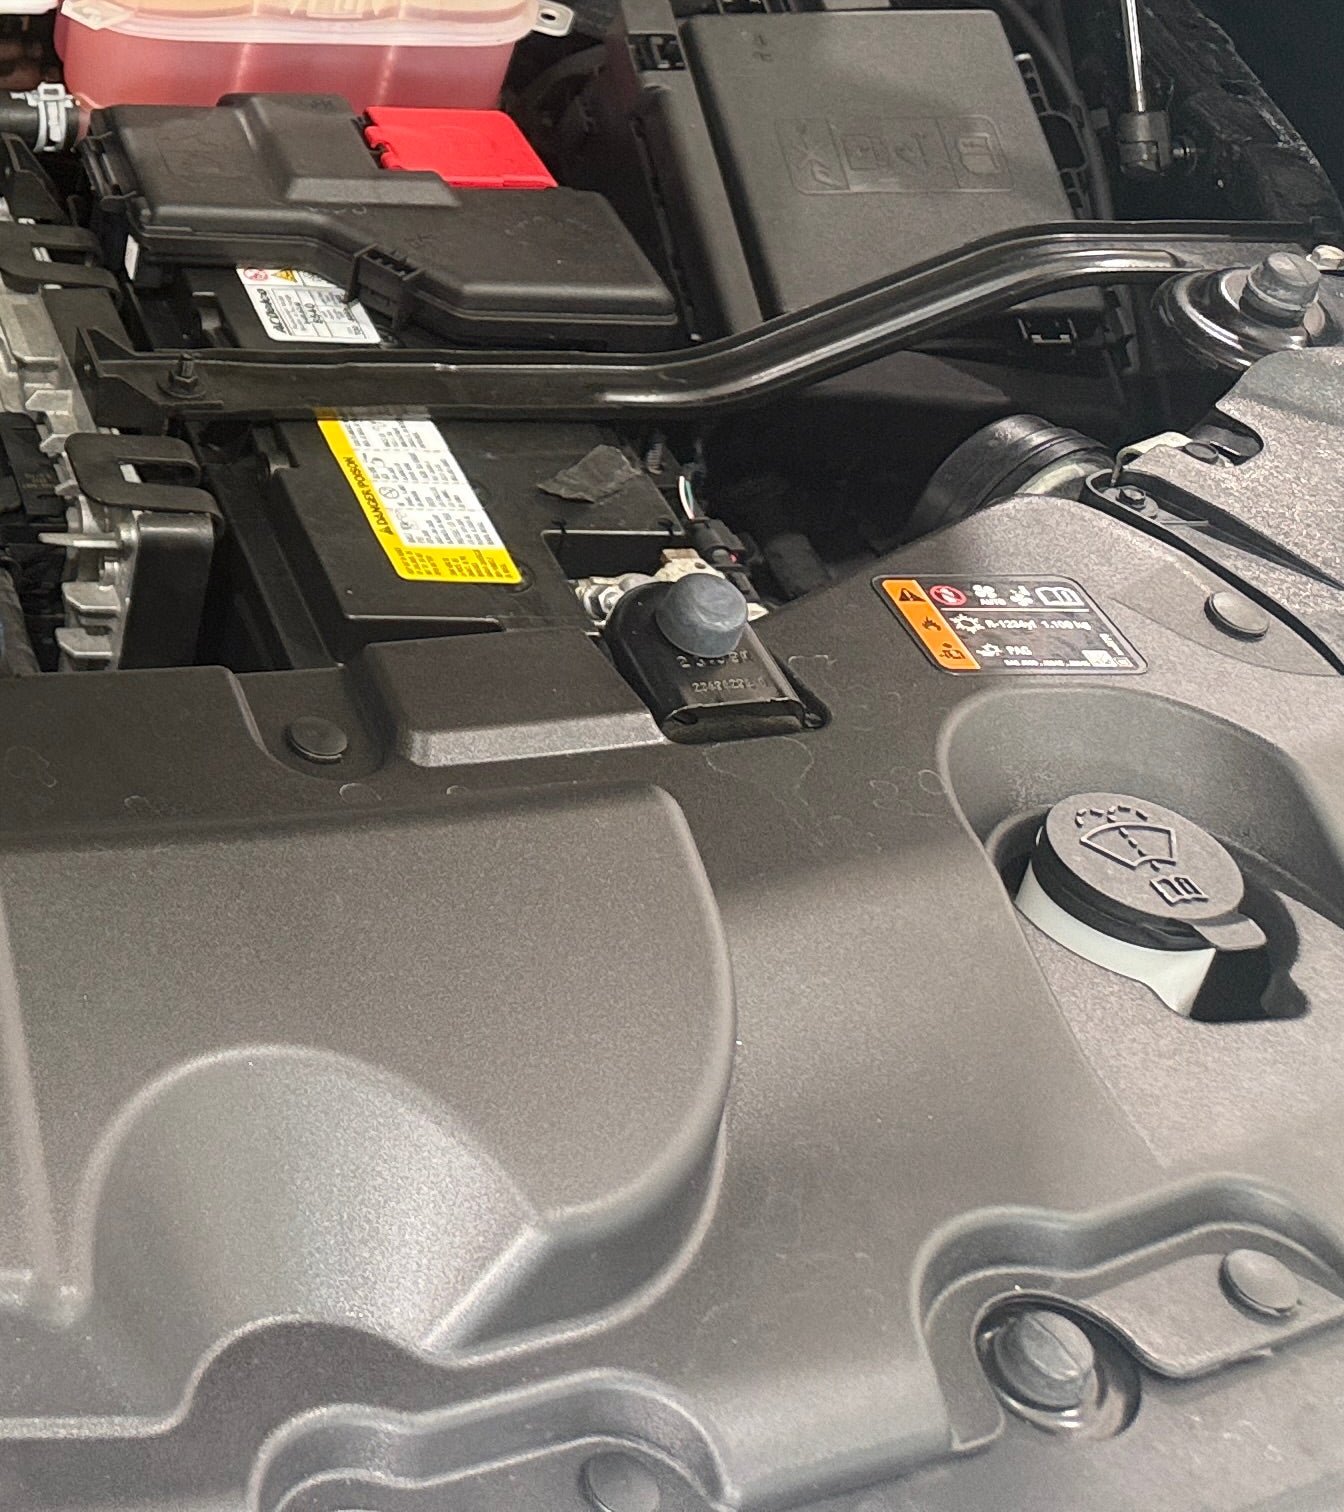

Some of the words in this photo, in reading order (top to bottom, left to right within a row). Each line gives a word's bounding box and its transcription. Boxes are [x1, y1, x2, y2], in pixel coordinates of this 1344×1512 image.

[343, 456, 369, 488] POISON
[361, 489, 388, 525] DANGER
[980, 598, 1007, 606] AUTO
